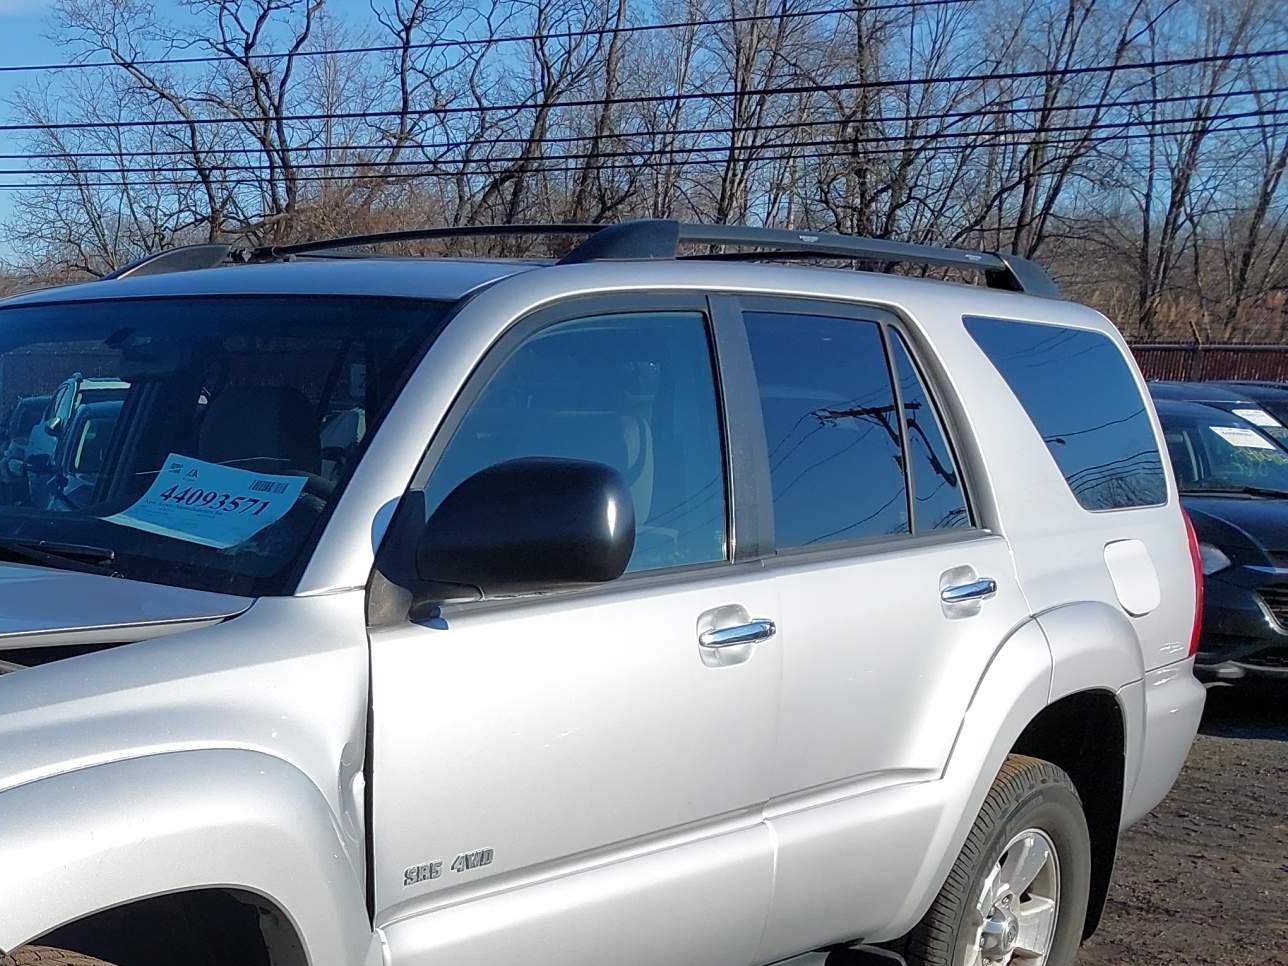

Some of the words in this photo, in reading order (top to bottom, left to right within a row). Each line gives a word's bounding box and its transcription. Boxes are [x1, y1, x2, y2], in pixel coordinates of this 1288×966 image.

[160, 483, 270, 517] 44093571
[403, 860, 443, 887] SR5
[450, 847, 495, 873] 4WD
